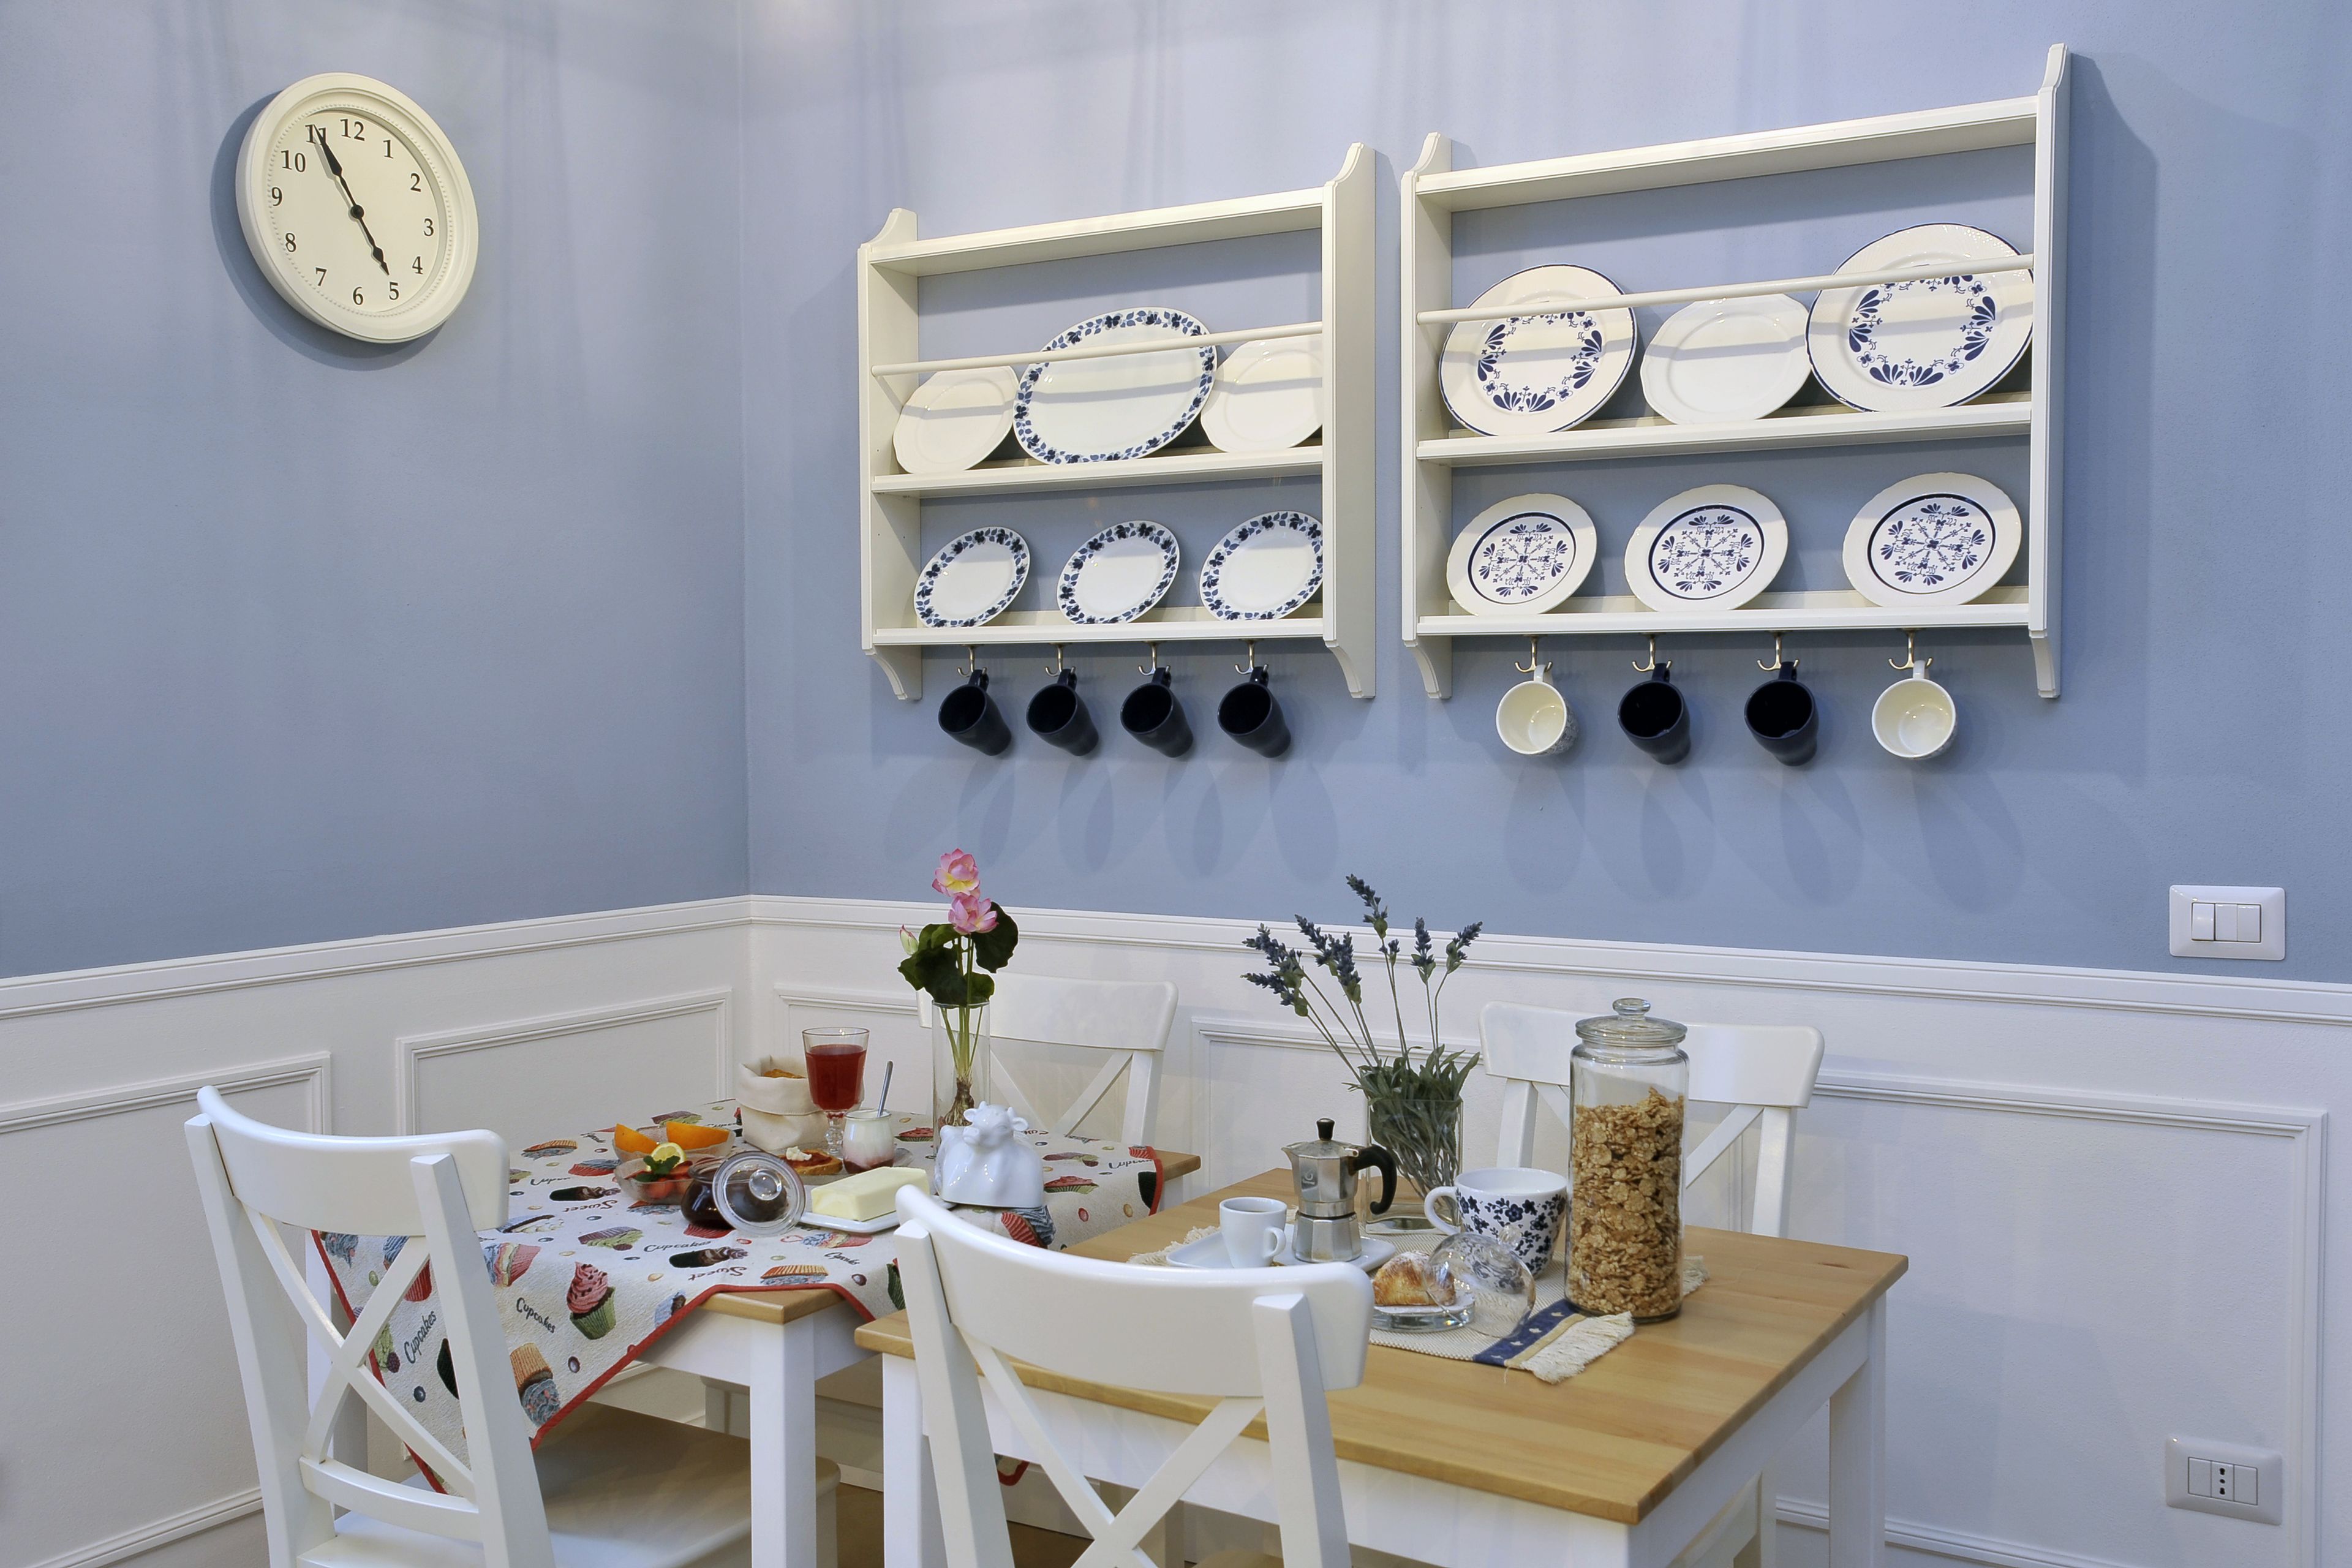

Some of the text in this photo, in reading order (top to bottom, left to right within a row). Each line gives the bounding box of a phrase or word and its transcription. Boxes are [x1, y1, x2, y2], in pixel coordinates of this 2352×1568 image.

[305, 124, 326, 146] 11
[340, 119, 365, 141] 12
[383, 140, 393, 159] 1
[281, 149, 306, 173] 10
[410, 173, 421, 192] 2
[271, 187, 282, 206] 9
[423, 218, 434, 236] 3
[285, 233, 296, 252] 8
[412, 256, 423, 274] 4
[315, 267, 327, 286] 7
[353, 287, 364, 305] 6
[389, 281, 399, 300] 5
[644, 1241, 711, 1253] Cupcakes
[687, 1267, 747, 1281] Sweet
[516, 1297, 556, 1333] Cupcakes
[404, 1311, 437, 1364] Cupcakes
